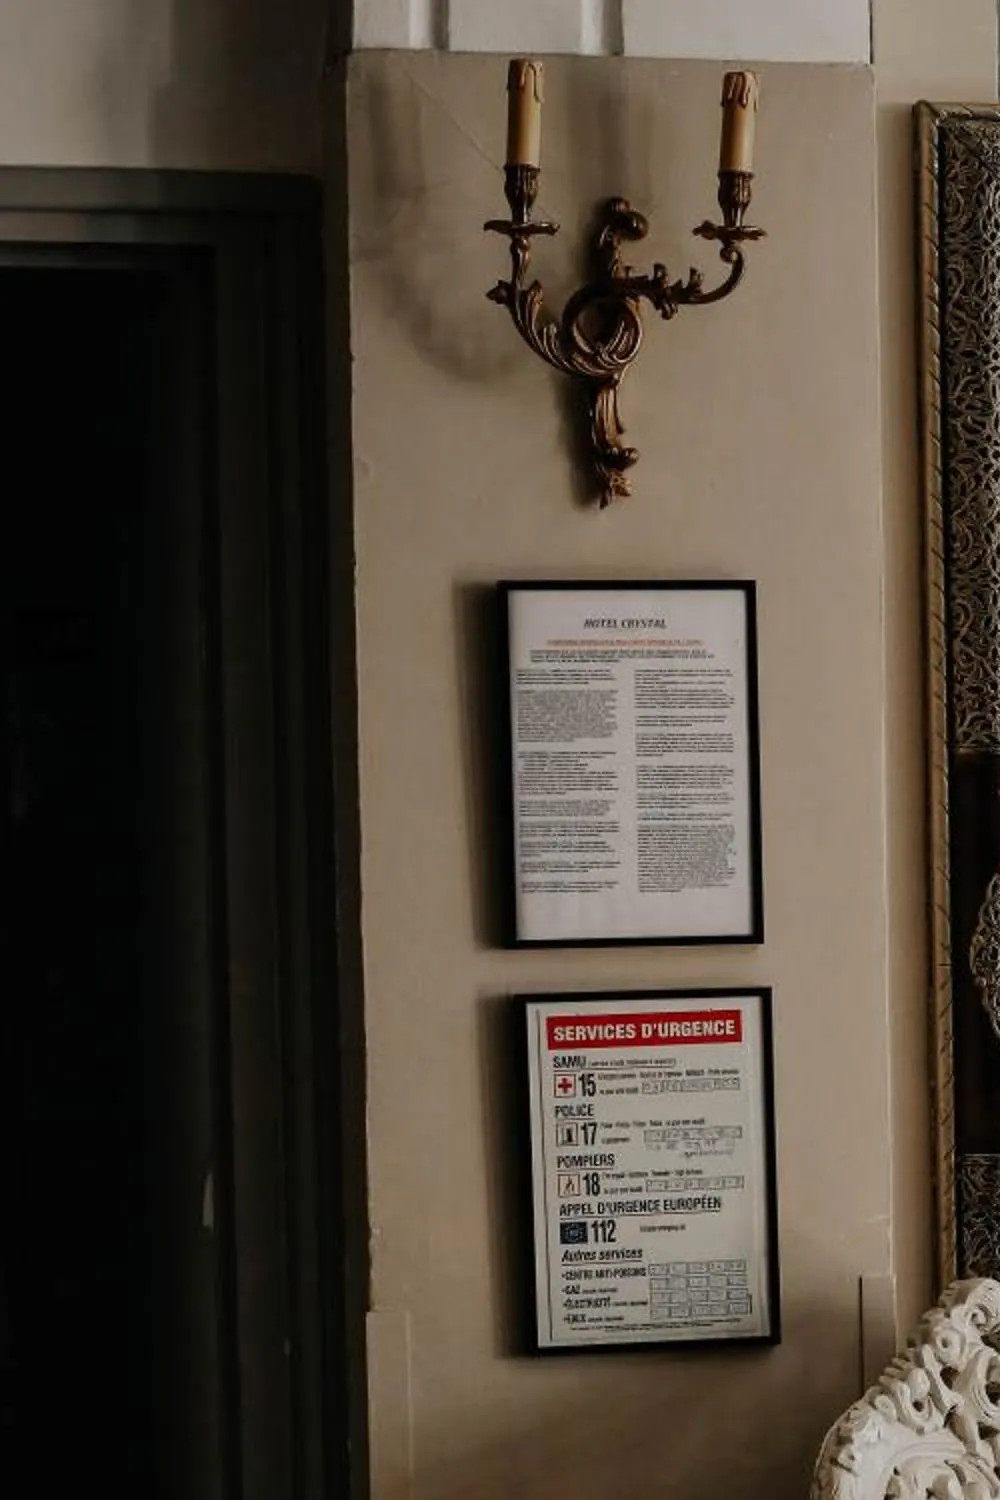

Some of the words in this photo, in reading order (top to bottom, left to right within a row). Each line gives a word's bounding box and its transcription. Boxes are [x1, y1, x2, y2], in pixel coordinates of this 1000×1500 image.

[583, 618, 618, 629] HOTEL
[621, 618, 667, 629] CRYSTAL
[553, 1024, 637, 1042] SERVICES
[641, 1019, 736, 1039] D'URGENCE
[552, 1056, 587, 1069] SAMU
[578, 1073, 597, 1097] 15
[554, 1103, 595, 1118] POLICE
[581, 1122, 598, 1146] 17
[556, 1153, 616, 1169] POMPIERS
[582, 1172, 601, 1197] 18
[559, 1203, 594, 1216] APPEL
[597, 1199, 660, 1214] D'URGENCE
[663, 1195, 722, 1211] EUROPÉEN
[591, 1219, 617, 1244] 112
[561, 1249, 597, 1263] Autres
[599, 1248, 643, 1260] services
